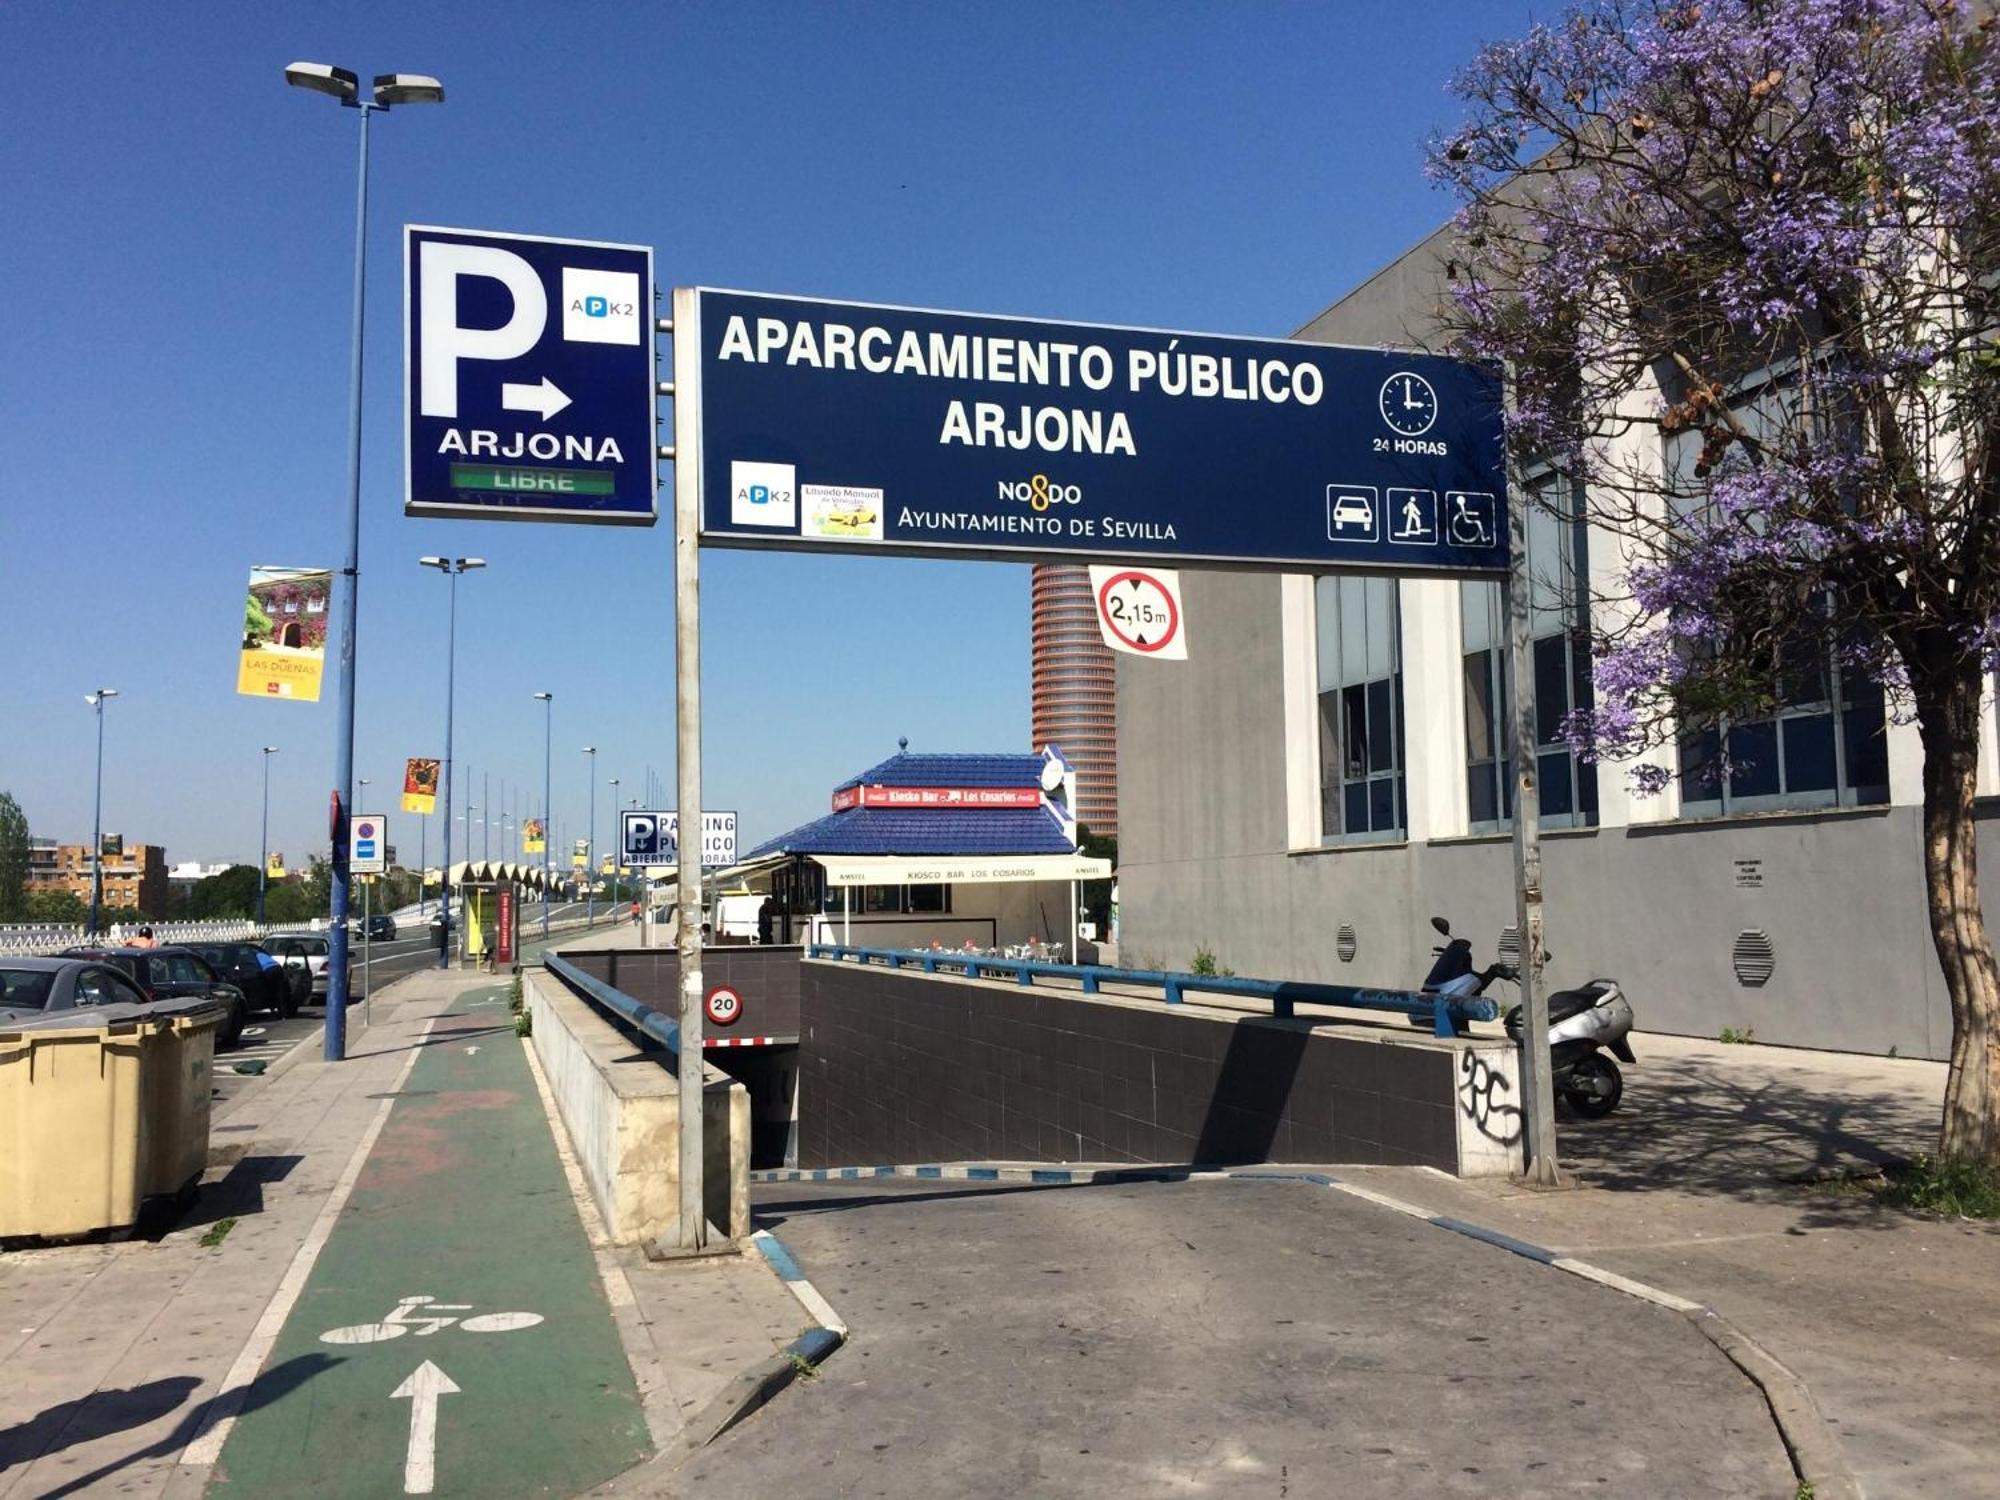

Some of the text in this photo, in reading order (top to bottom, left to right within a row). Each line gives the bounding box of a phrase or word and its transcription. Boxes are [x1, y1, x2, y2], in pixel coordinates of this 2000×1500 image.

[419, 240, 548, 419] P
[718, 315, 1324, 406] APARCAMIENTO PÚBLICO
[939, 400, 1138, 456] ARJONA
[437, 427, 625, 464] ARJONA
[1373, 438, 1448, 456] 24 HORAS
[493, 469, 576, 491] LIBRE
[659, 818, 734, 831] PAING
[624, 854, 673, 864] ABIERTO
[714, 998, 734, 1010] 20
